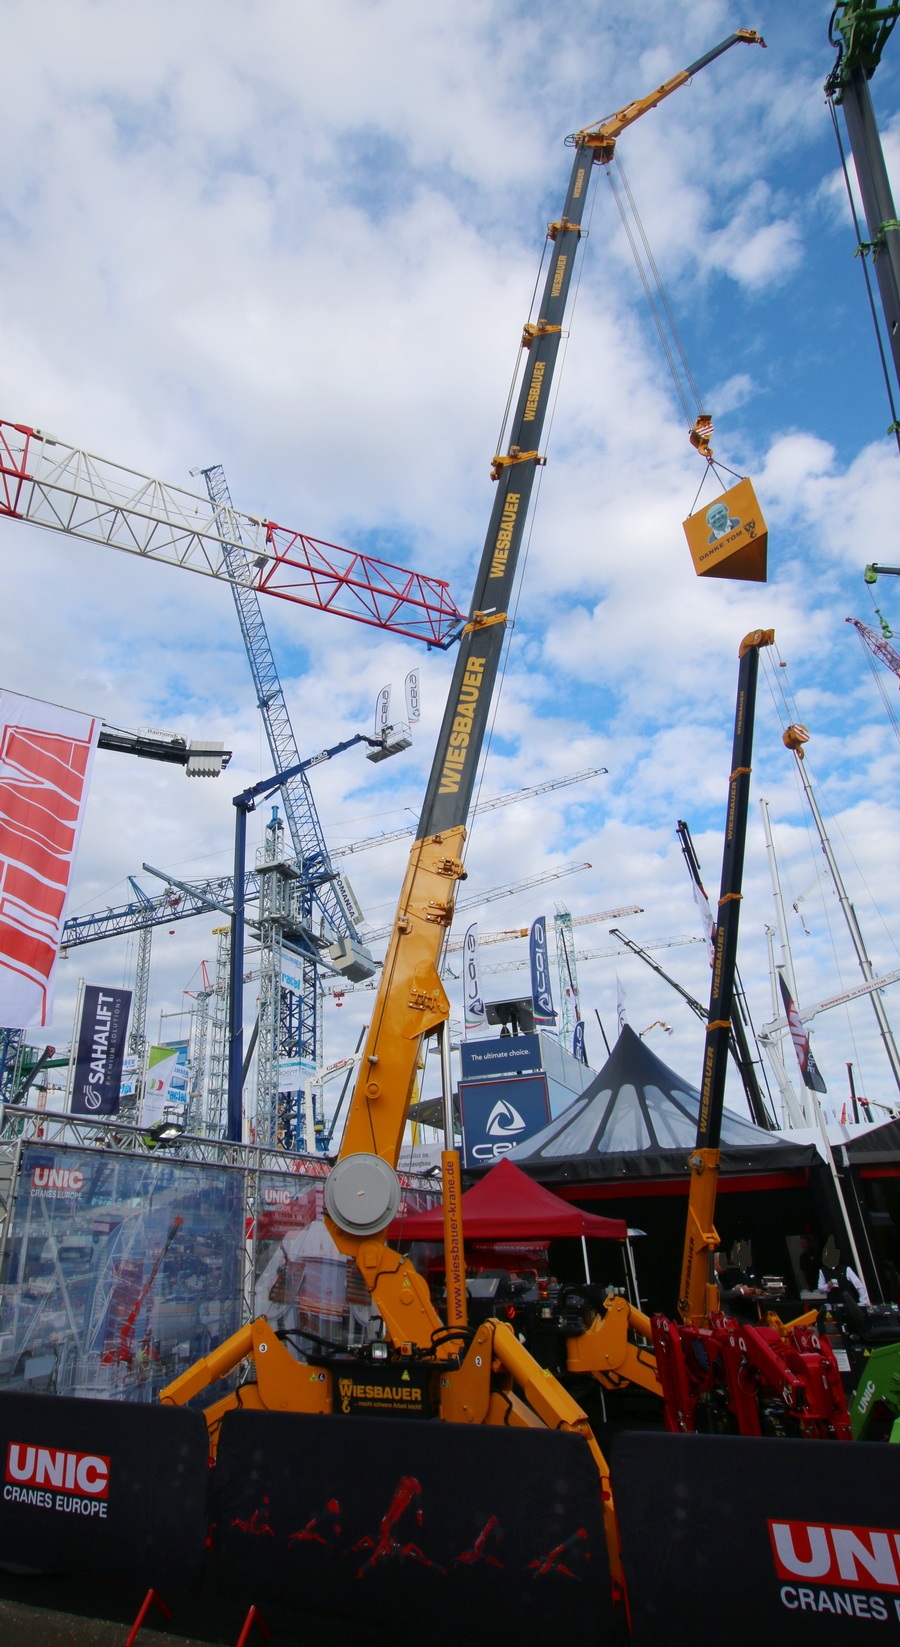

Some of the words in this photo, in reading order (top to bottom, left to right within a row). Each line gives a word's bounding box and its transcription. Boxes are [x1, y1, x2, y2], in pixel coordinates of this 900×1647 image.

[573, 168, 585, 198] WIESBAUER
[551, 255, 567, 297] WIESBAUER
[523, 361, 546, 421] WIESBAUER
[490, 492, 521, 578] WIESBAUER
[699, 543, 725, 561] DANKE
[726, 530, 743, 544] TOM
[438, 656, 486, 794] WIESBAUER
[736, 691, 745, 735] WIESBAUER
[727, 781, 737, 841] WIESBAUER
[712, 926, 725, 999] WIESBAUER
[88, 992, 114, 1084] SAHALIFT
[105, 1047, 116, 1085] PREMIUM
[111, 998, 121, 1044] SOLUTIONS
[483, 1052, 508, 1060] ultimate
[509, 1049, 531, 1057] choice.
[699, 1046, 715, 1133] WIESBAUER
[31, 1189, 57, 1198] CRANES
[57, 1191, 83, 1200] EUROPE
[34, 1168, 84, 1189] UNIC
[265, 1189, 291, 1204] UNIC
[445, 1161, 463, 1320] www.wiesbauer-krane.de
[684, 1237, 695, 1300] WIESBAUER
[340, 1384, 422, 1401] WIESBAUER
[858, 1380, 876, 1414] UNIC
[9, 1444, 108, 1493] UNIC
[3, 1485, 53, 1508] CRANES
[55, 1496, 108, 1518] EUROPE
[780, 1586, 888, 1620] CRANES
